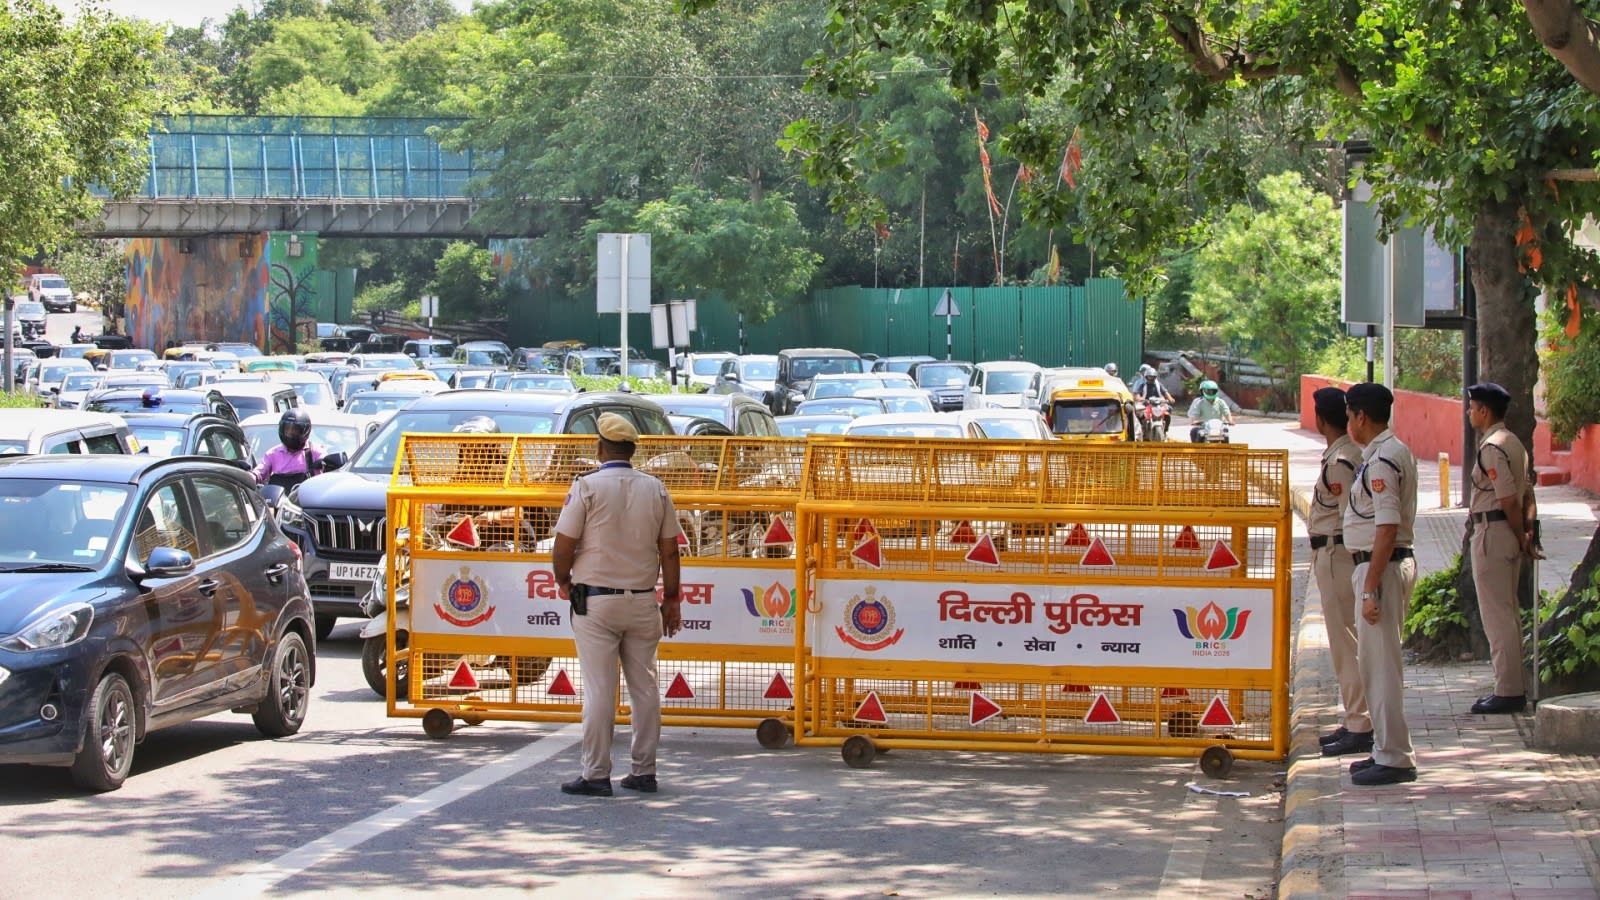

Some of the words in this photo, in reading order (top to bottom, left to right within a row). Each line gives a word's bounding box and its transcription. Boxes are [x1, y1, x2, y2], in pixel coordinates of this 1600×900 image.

[336, 565, 379, 578] UP14FZ7
[527, 611, 561, 626] शांति
[681, 619, 712, 631] याय
[937, 590, 1036, 625] दिल्ली
[1044, 593, 1144, 635] पुलिस
[938, 634, 977, 650] शांति
[1024, 636, 1056, 652] सेवा
[1101, 641, 1141, 654] न्याय
[1195, 641, 1226, 650] BRICS
